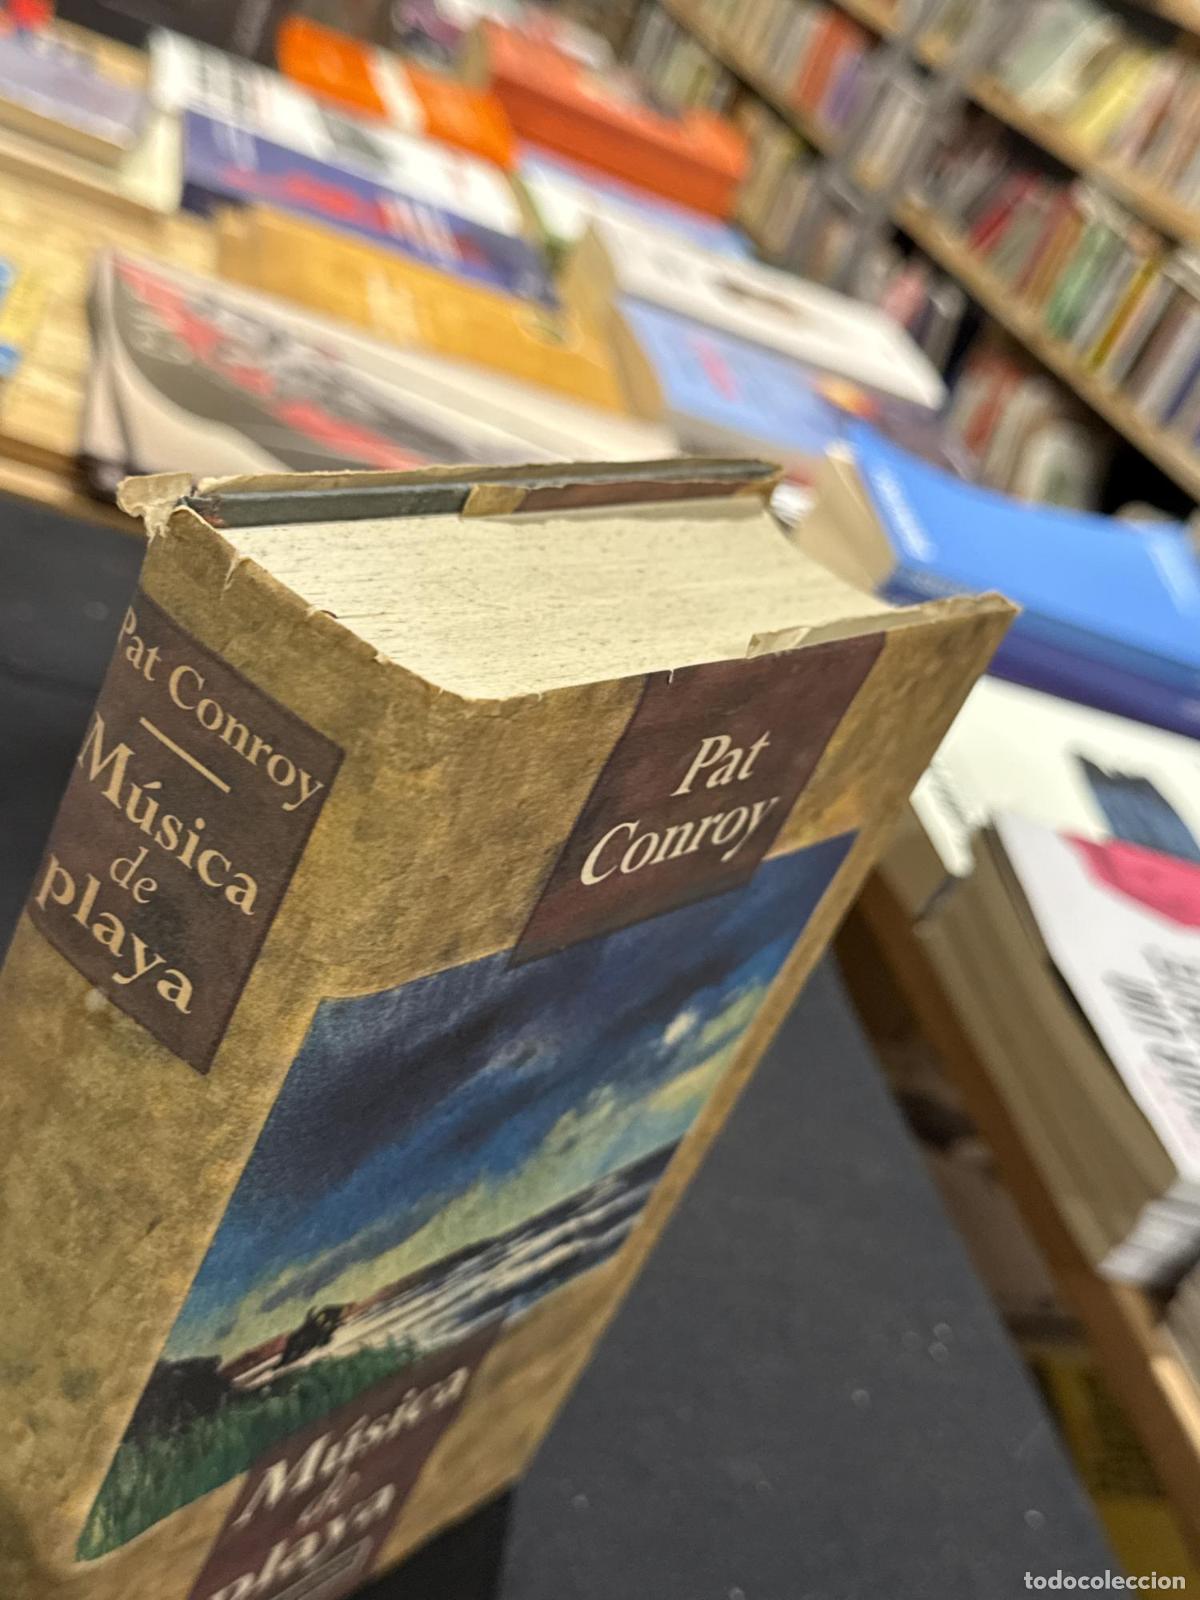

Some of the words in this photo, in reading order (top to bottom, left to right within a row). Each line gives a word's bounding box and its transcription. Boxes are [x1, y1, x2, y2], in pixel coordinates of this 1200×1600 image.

[118, 605, 163, 682] Pat
[168, 664, 324, 812] Conroy
[670, 730, 771, 797] Pat
[78, 711, 257, 916] Música
[109, 846, 158, 904] de
[580, 796, 780, 886] Conroy
[35, 855, 193, 1015] playa
